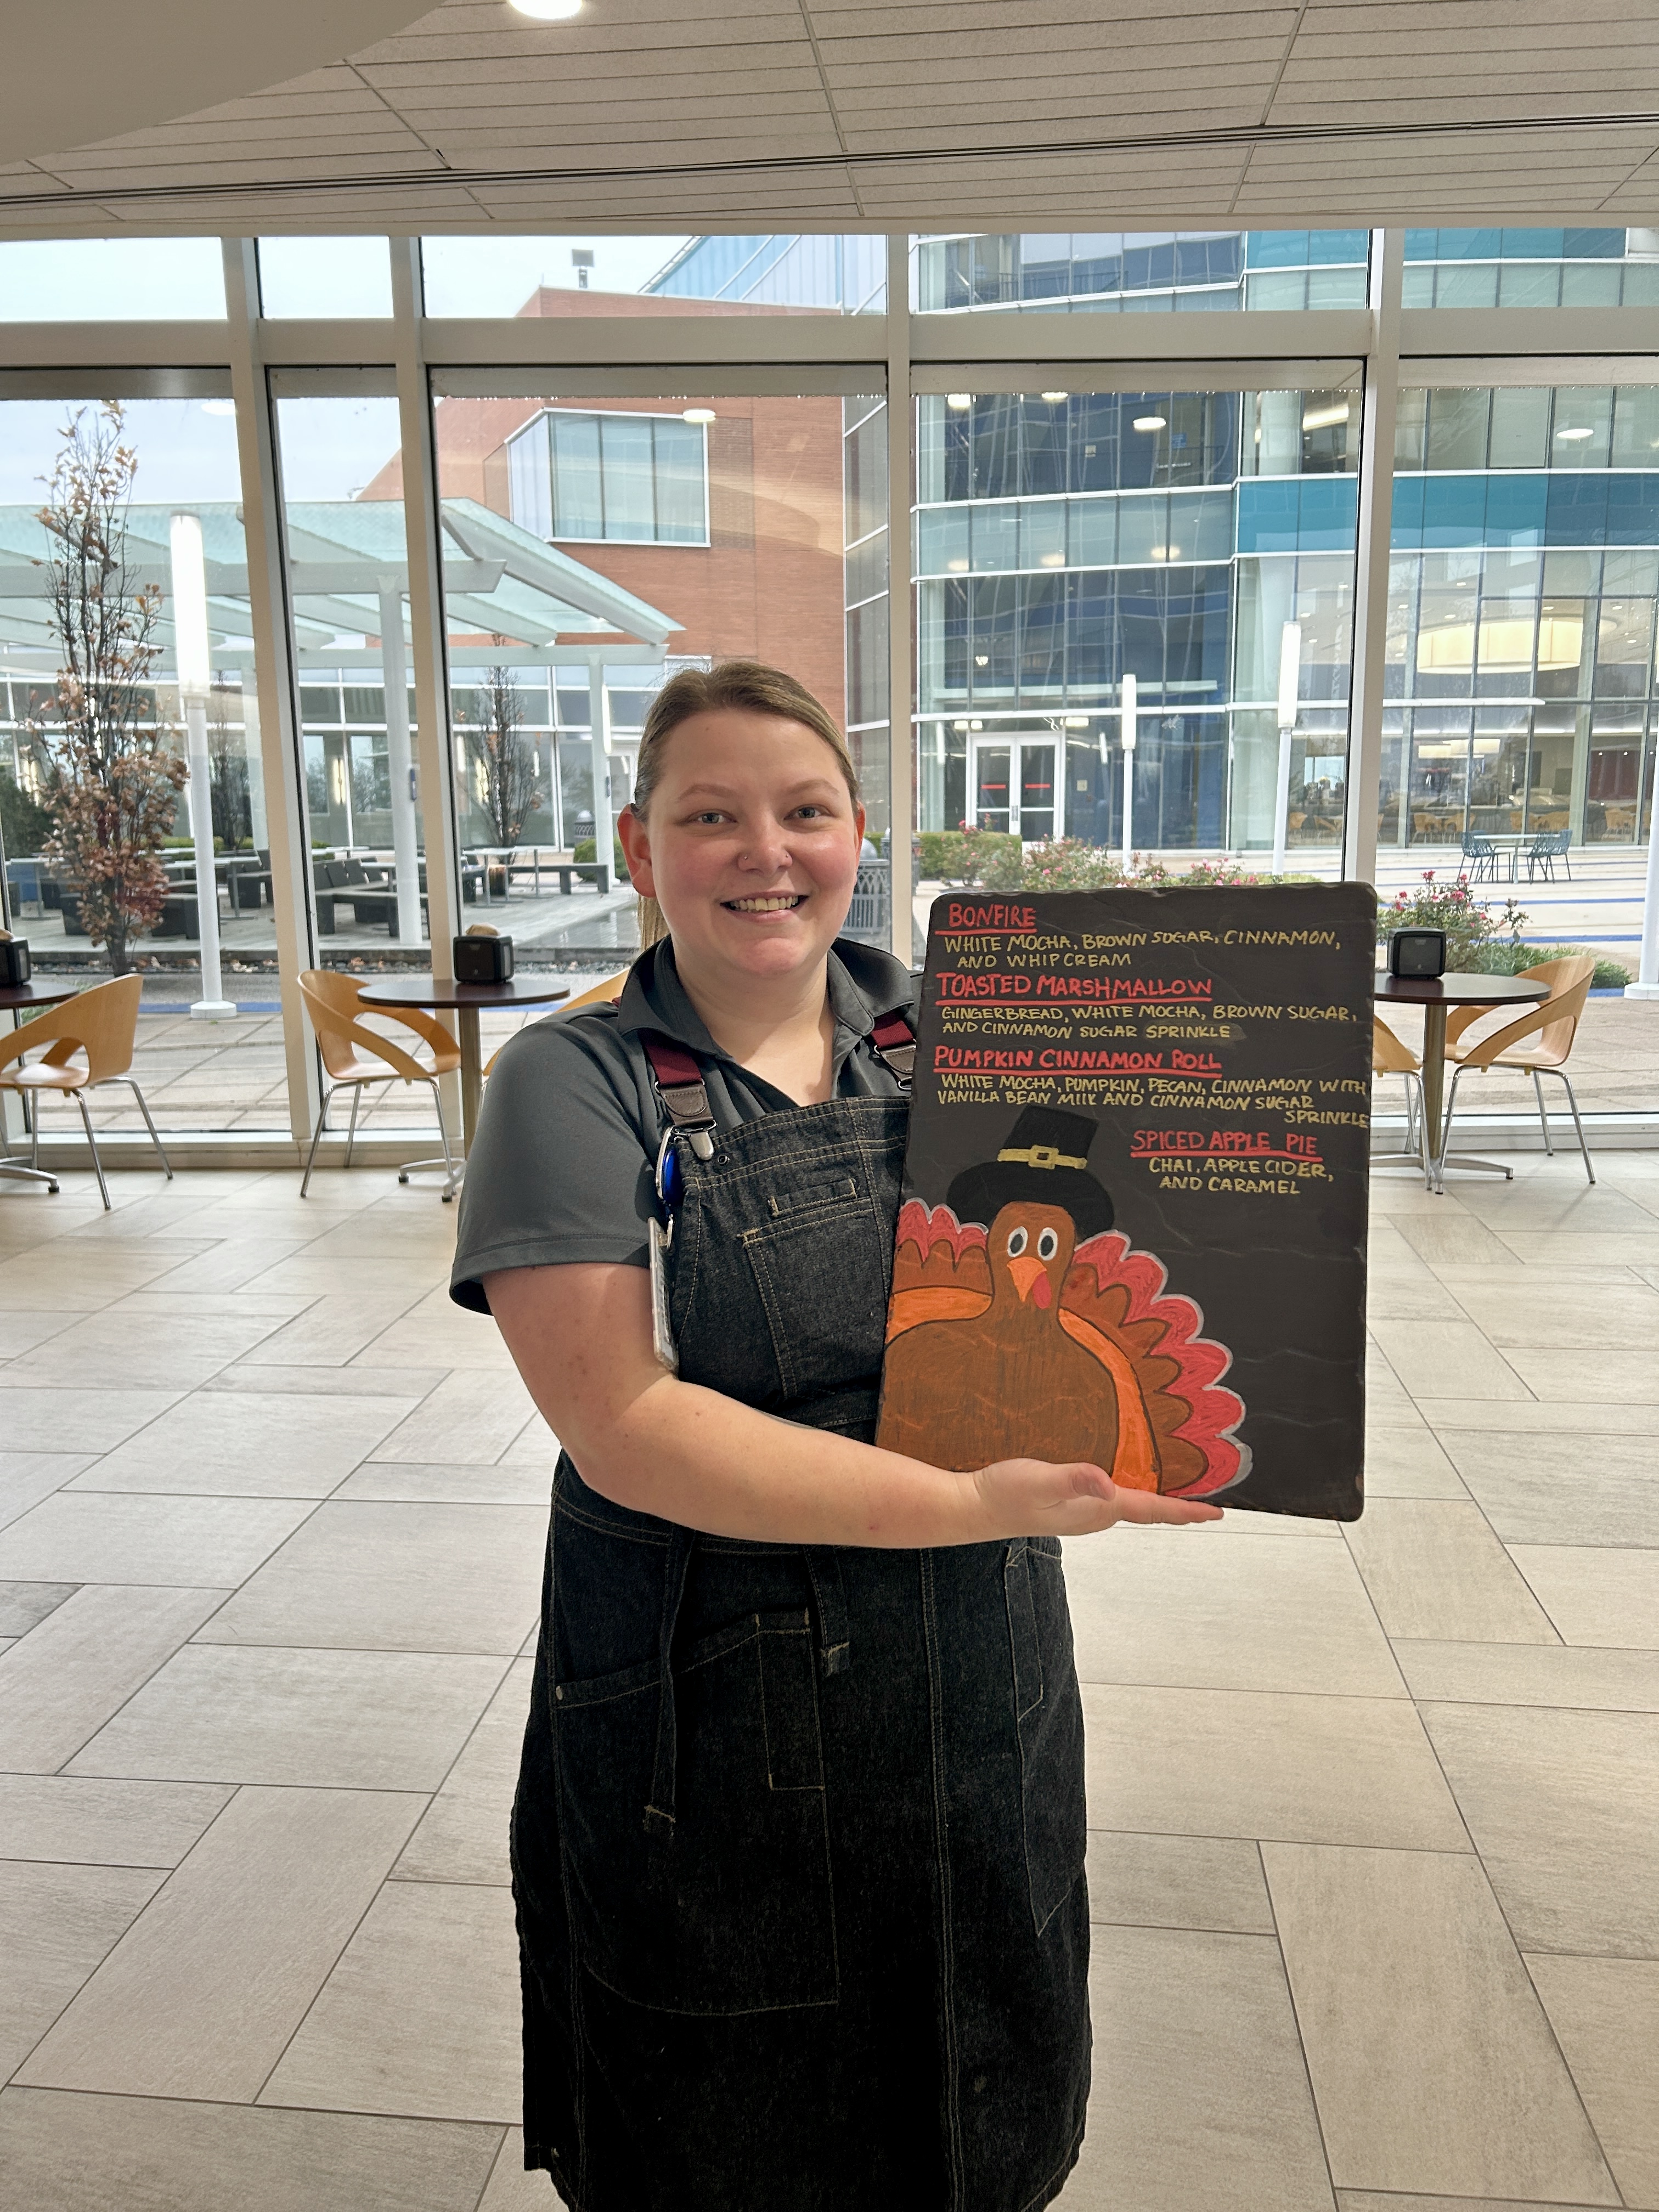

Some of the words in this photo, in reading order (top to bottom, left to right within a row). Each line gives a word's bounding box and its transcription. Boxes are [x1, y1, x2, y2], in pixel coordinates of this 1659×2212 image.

[949, 902, 1036, 928] BONFIRE
[944, 936, 1001, 953] WHITE
[1007, 934, 1078, 951] MOCHA,
[1081, 932, 1147, 950] BROWN
[1151, 930, 1219, 944] SUGAR,
[1223, 930, 1341, 950] CINNAMON,
[957, 955, 997, 969] AND
[935, 972, 1031, 998] TOASTED
[1036, 975, 1212, 1000] MARSHMALLOW
[941, 1006, 1069, 1023] GINGERBREAD,
[1071, 1006, 1133, 1019] WHITE
[1138, 1005, 1206, 1020] MOCHA,
[1212, 1005, 1283, 1019] BROWN
[1287, 1005, 1357, 1022] SUGAR,
[943, 1022, 978, 1033] AND
[981, 1022, 1073, 1039] CINNAMON
[1079, 1025, 1138, 1037] SUGAR
[1145, 1025, 1231, 1040] SPRINKLE
[934, 1045, 1034, 1068] PUMPKIN
[1039, 1048, 1163, 1069] CINNAMON
[1171, 1048, 1222, 1070] ROLL
[941, 1073, 994, 1089] WHITE
[999, 1075, 1062, 1093] MOCHA,
[1064, 1077, 1145, 1093] PUMPKIN,
[1148, 1077, 1207, 1094] PECAN,
[1211, 1079, 1312, 1094] CINNAMON
[1319, 1079, 1367, 1095] WITH
[937, 1090, 1000, 1104] VANILLA
[1005, 1091, 1051, 1105] BEAN
[1102, 1092, 1144, 1107] AND
[1150, 1094, 1251, 1111] CINNAMON
[1255, 1095, 1315, 1110] SUGAR
[1284, 1110, 1369, 1129] SPRINKLE
[1130, 1130, 1205, 1151] SPICED
[1209, 1131, 1271, 1152] APPLE
[1285, 1133, 1317, 1155] PIE
[1149, 1157, 1201, 1173] CHAI,
[1204, 1158, 1260, 1174] APPLE
[1264, 1160, 1334, 1183] CIDER,
[1159, 1176, 1203, 1190] AND
[1207, 1177, 1301, 1194] CARAMEL
